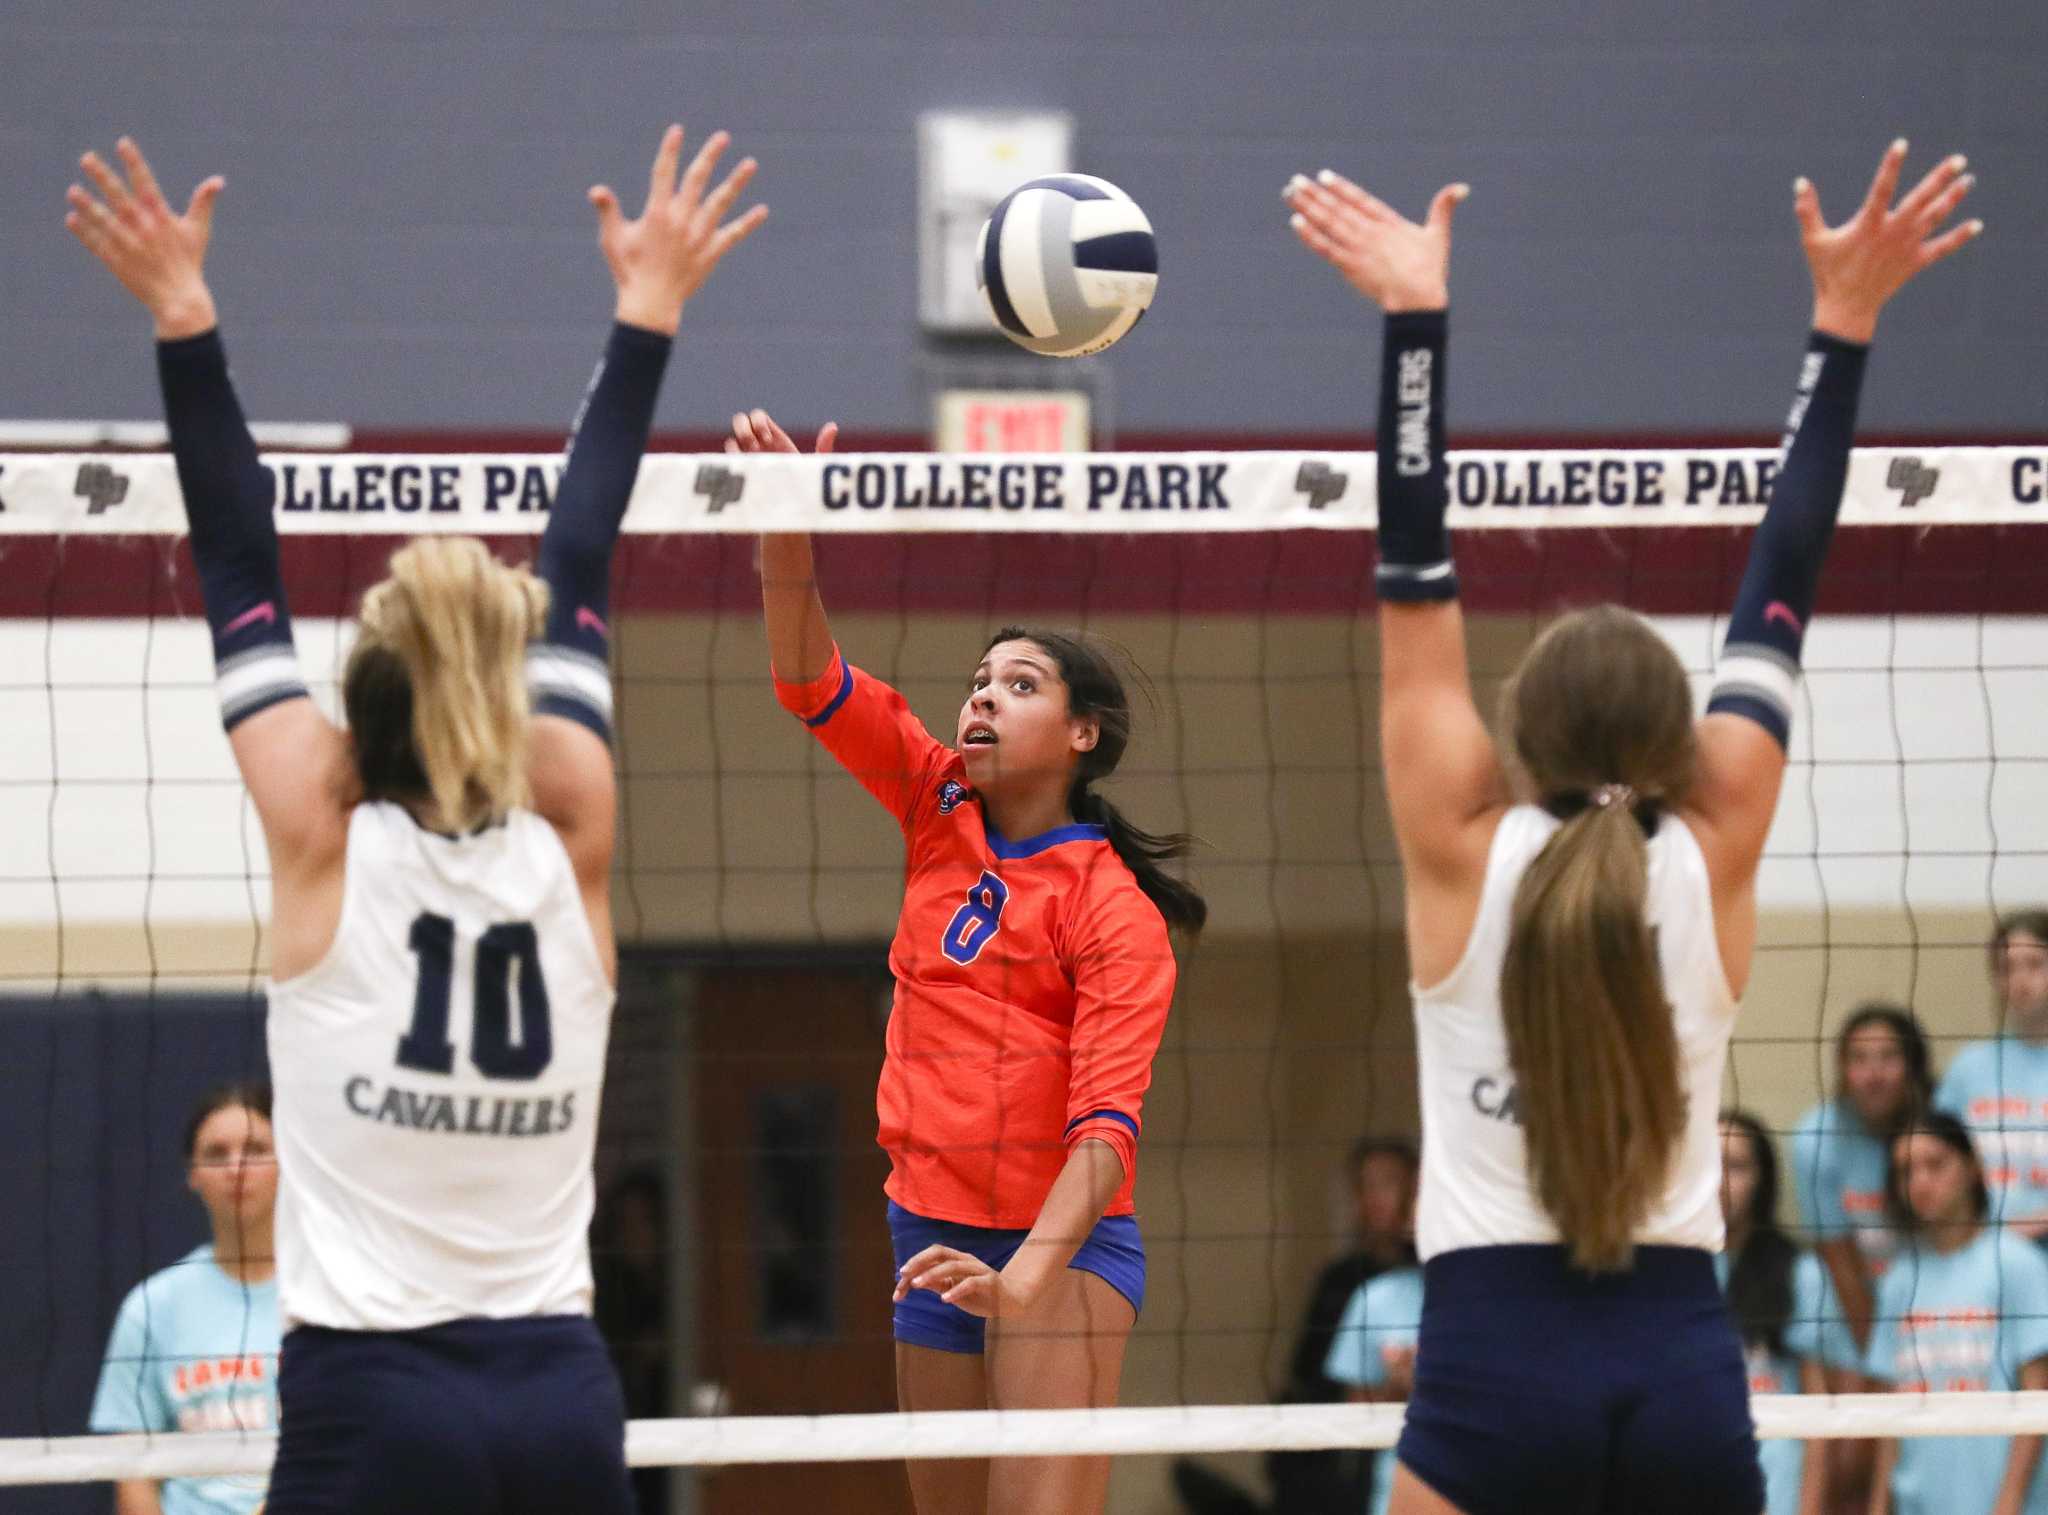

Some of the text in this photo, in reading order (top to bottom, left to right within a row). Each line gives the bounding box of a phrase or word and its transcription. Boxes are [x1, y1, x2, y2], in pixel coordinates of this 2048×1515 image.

[281, 465, 557, 513] LLEGE PA
[821, 462, 1231, 511] COLLEGE PARK
[1456, 460, 1665, 508] OLLEGE
[942, 869, 1010, 966] 8
[395, 907, 553, 1081] 10
[343, 1075, 576, 1138] CAVALIERS
